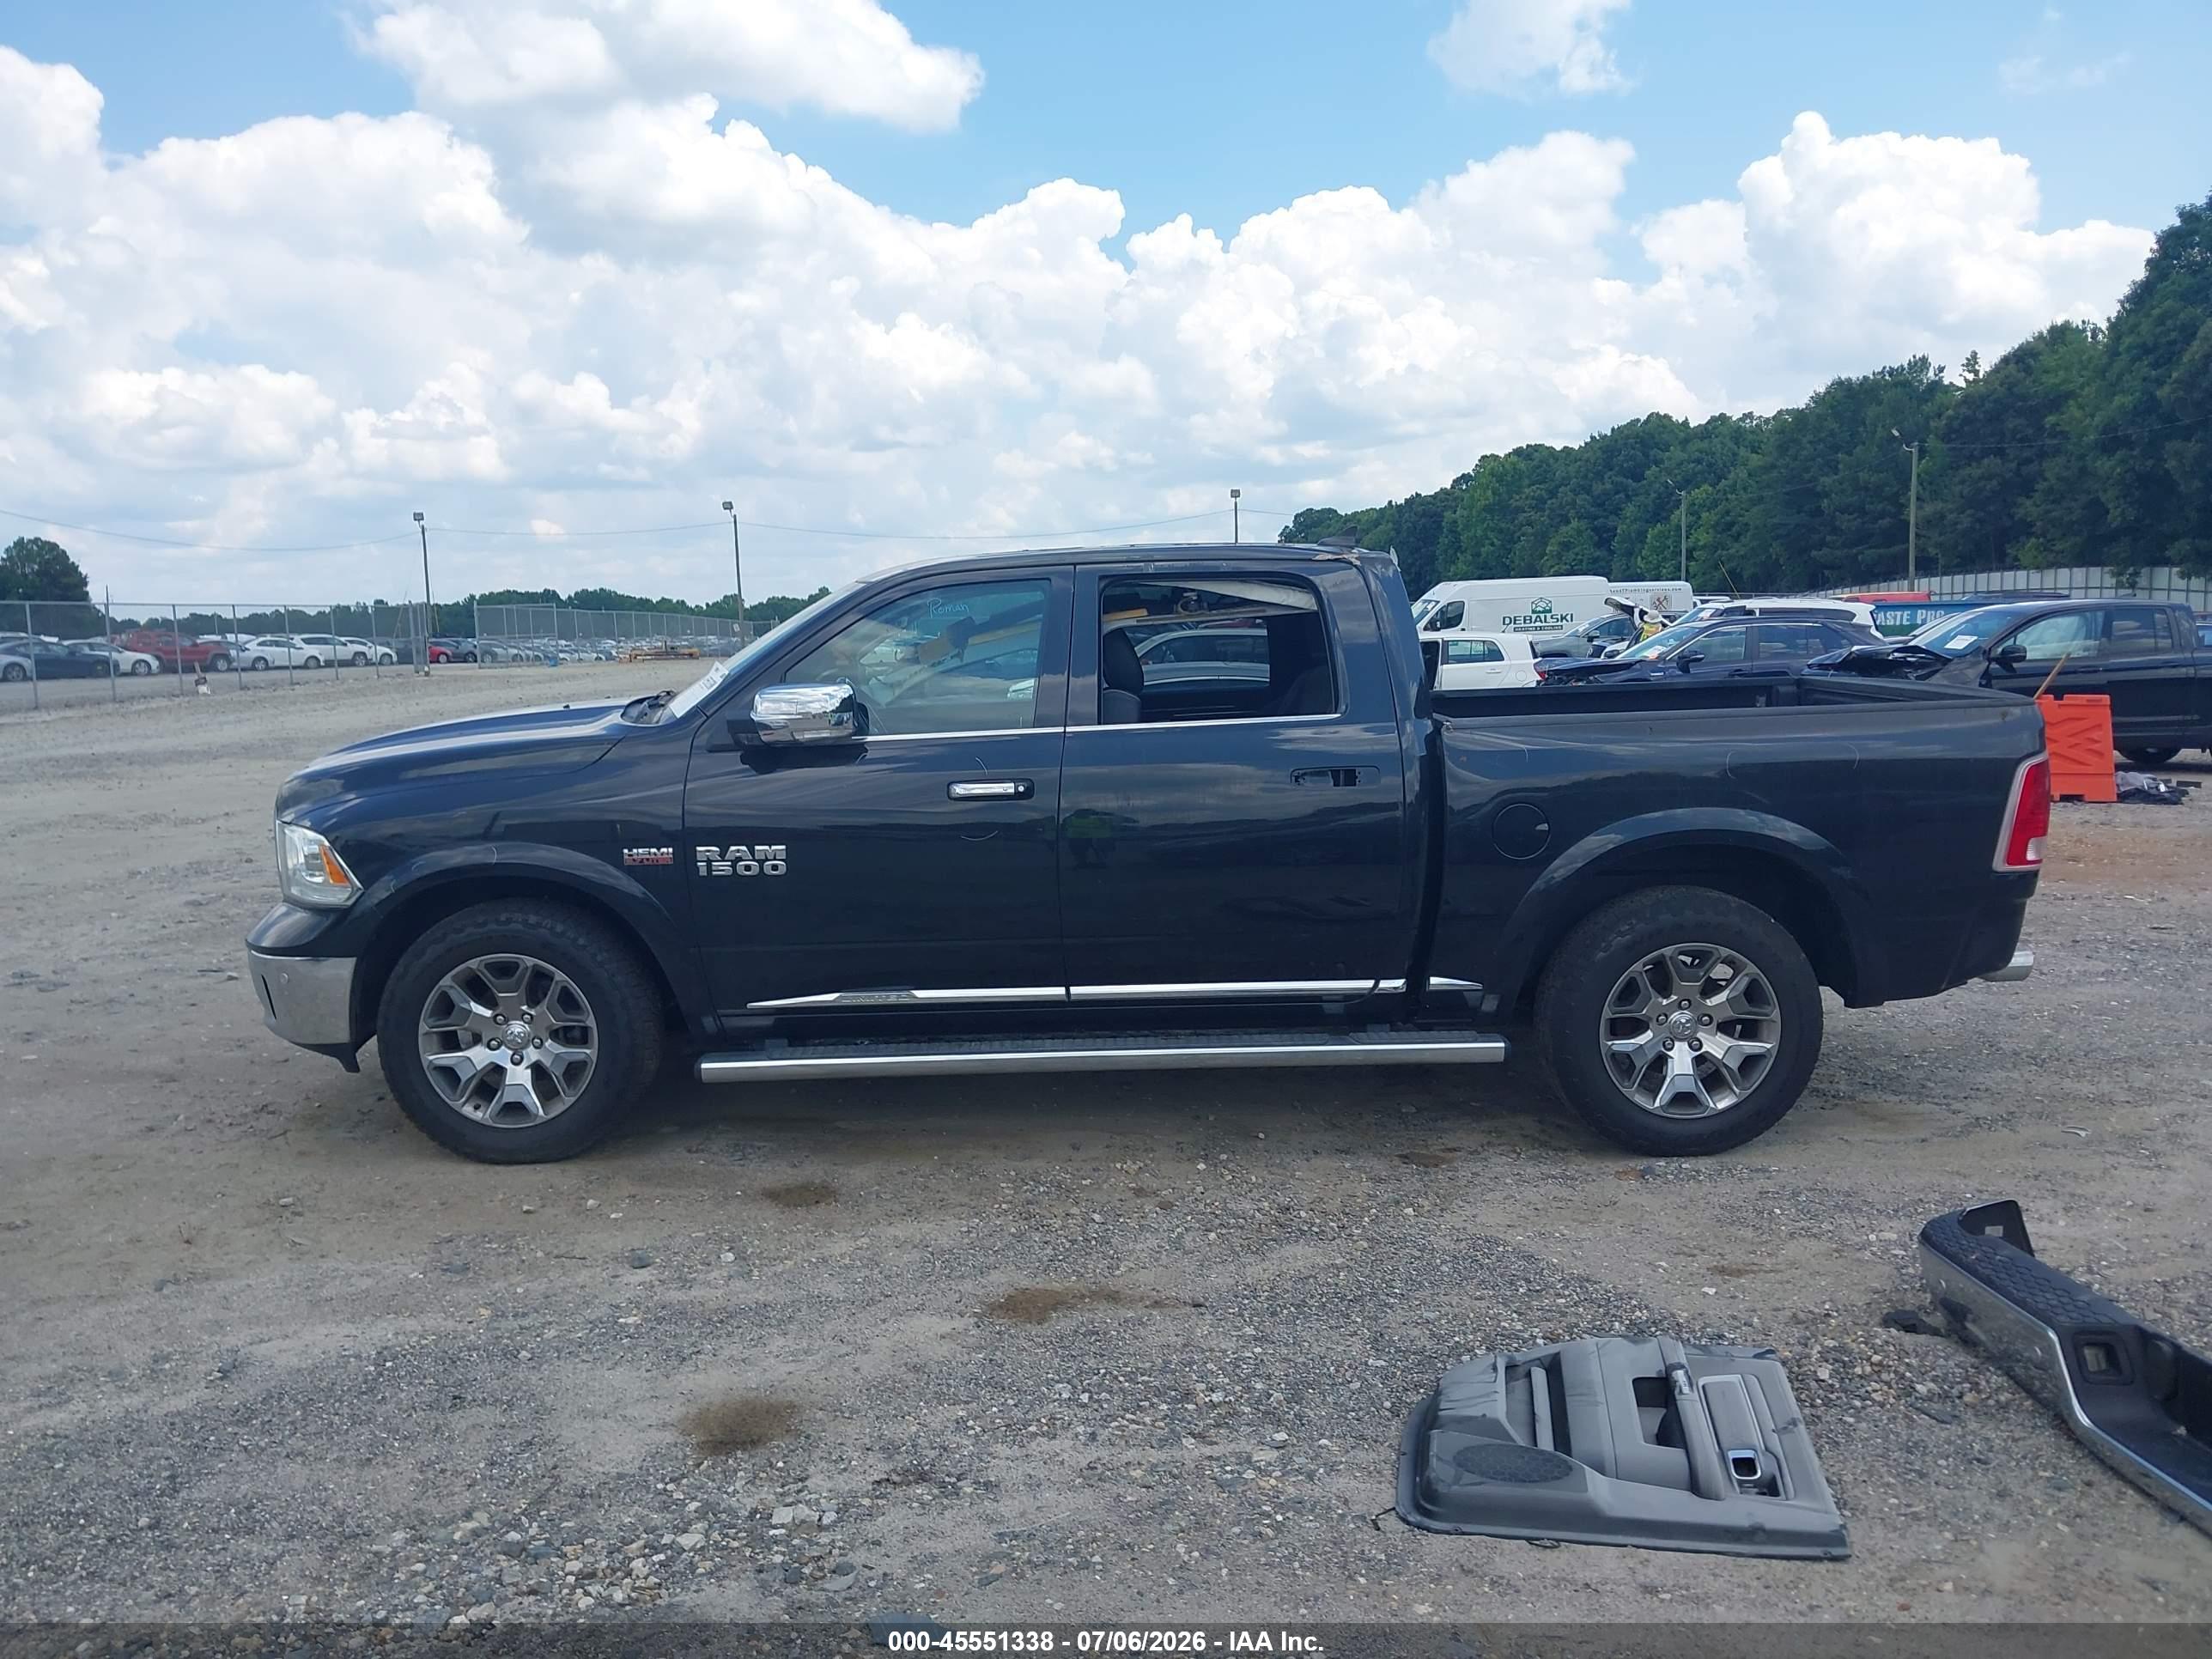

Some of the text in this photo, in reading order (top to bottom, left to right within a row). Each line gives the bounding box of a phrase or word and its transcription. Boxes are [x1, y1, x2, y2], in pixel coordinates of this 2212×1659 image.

[927, 598, 969, 618] Roman
[1502, 612, 1574, 626] DEBALSKI
[1874, 611, 1911, 625] ASTE
[623, 847, 674, 858] HEMI
[696, 845, 787, 860] RAM
[696, 860, 787, 877] 1500
